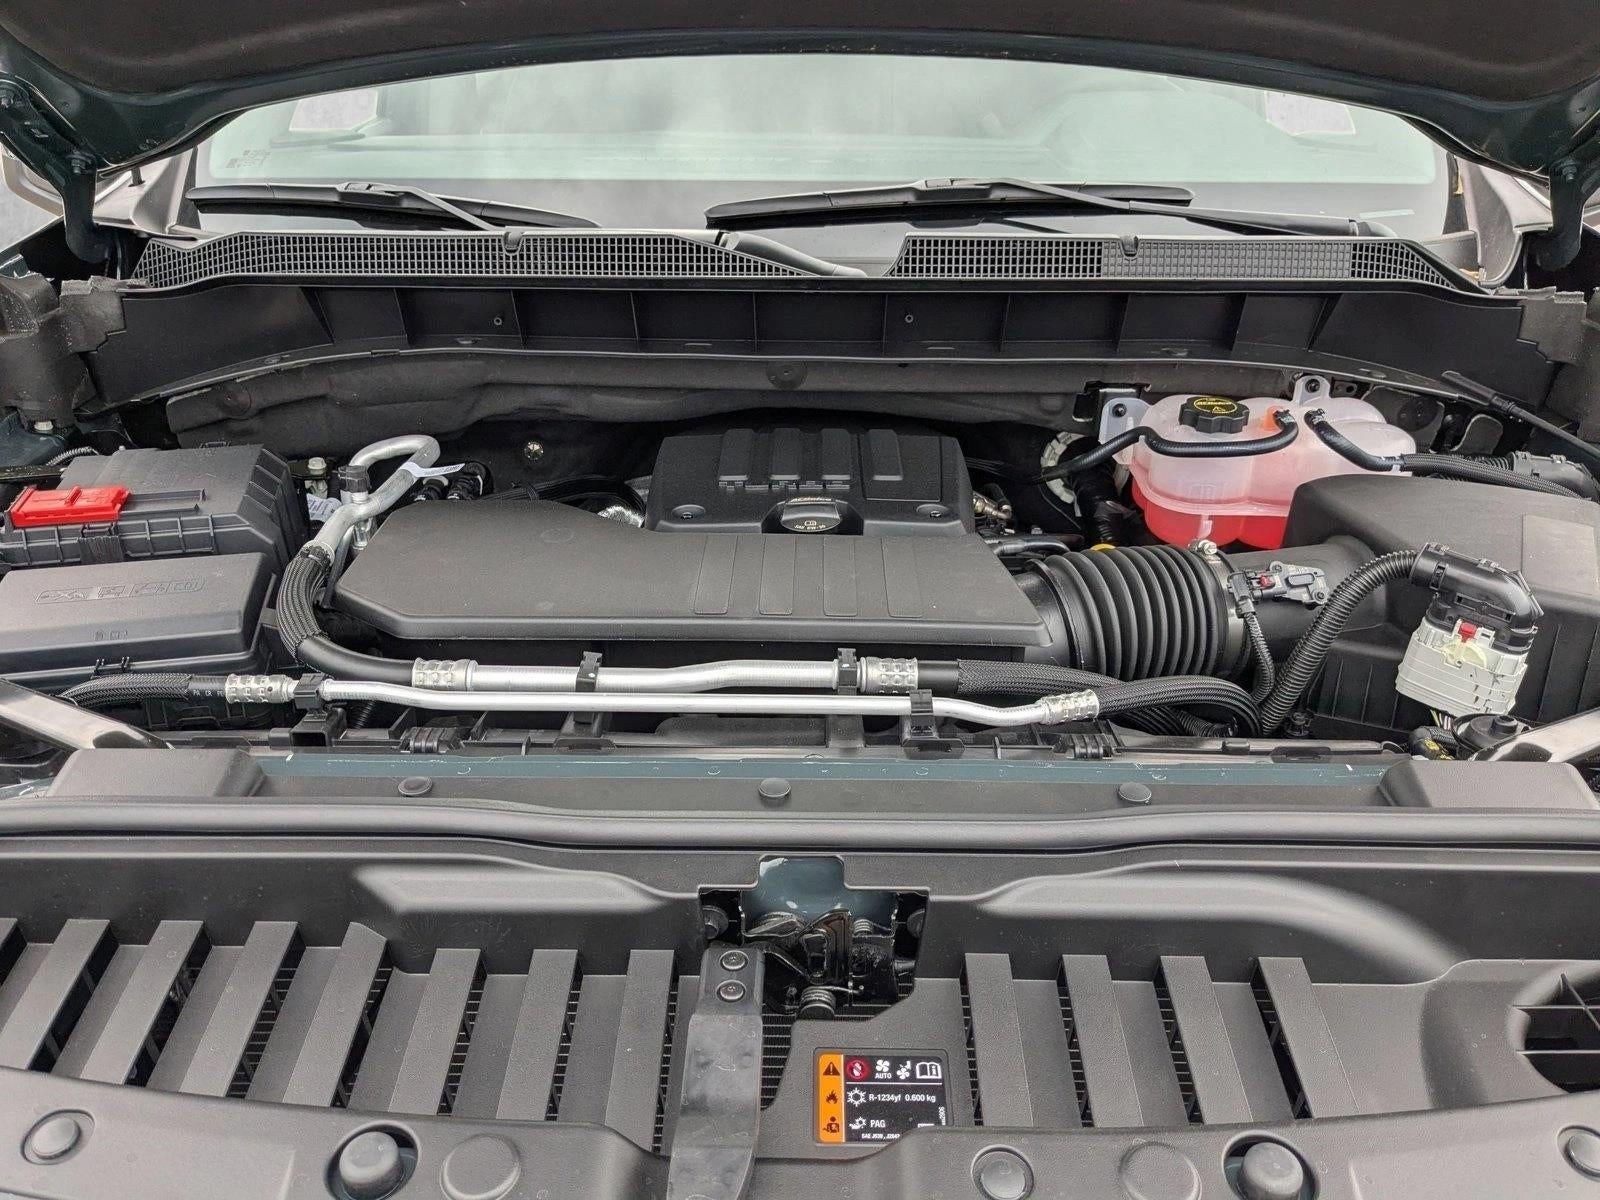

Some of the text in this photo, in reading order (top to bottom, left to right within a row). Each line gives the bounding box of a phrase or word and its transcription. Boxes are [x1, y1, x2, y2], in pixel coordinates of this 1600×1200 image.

[869, 1094, 901, 1102] R-1234yf
[926, 1094, 936, 1103] kg
[870, 1120, 886, 1128] PAG
